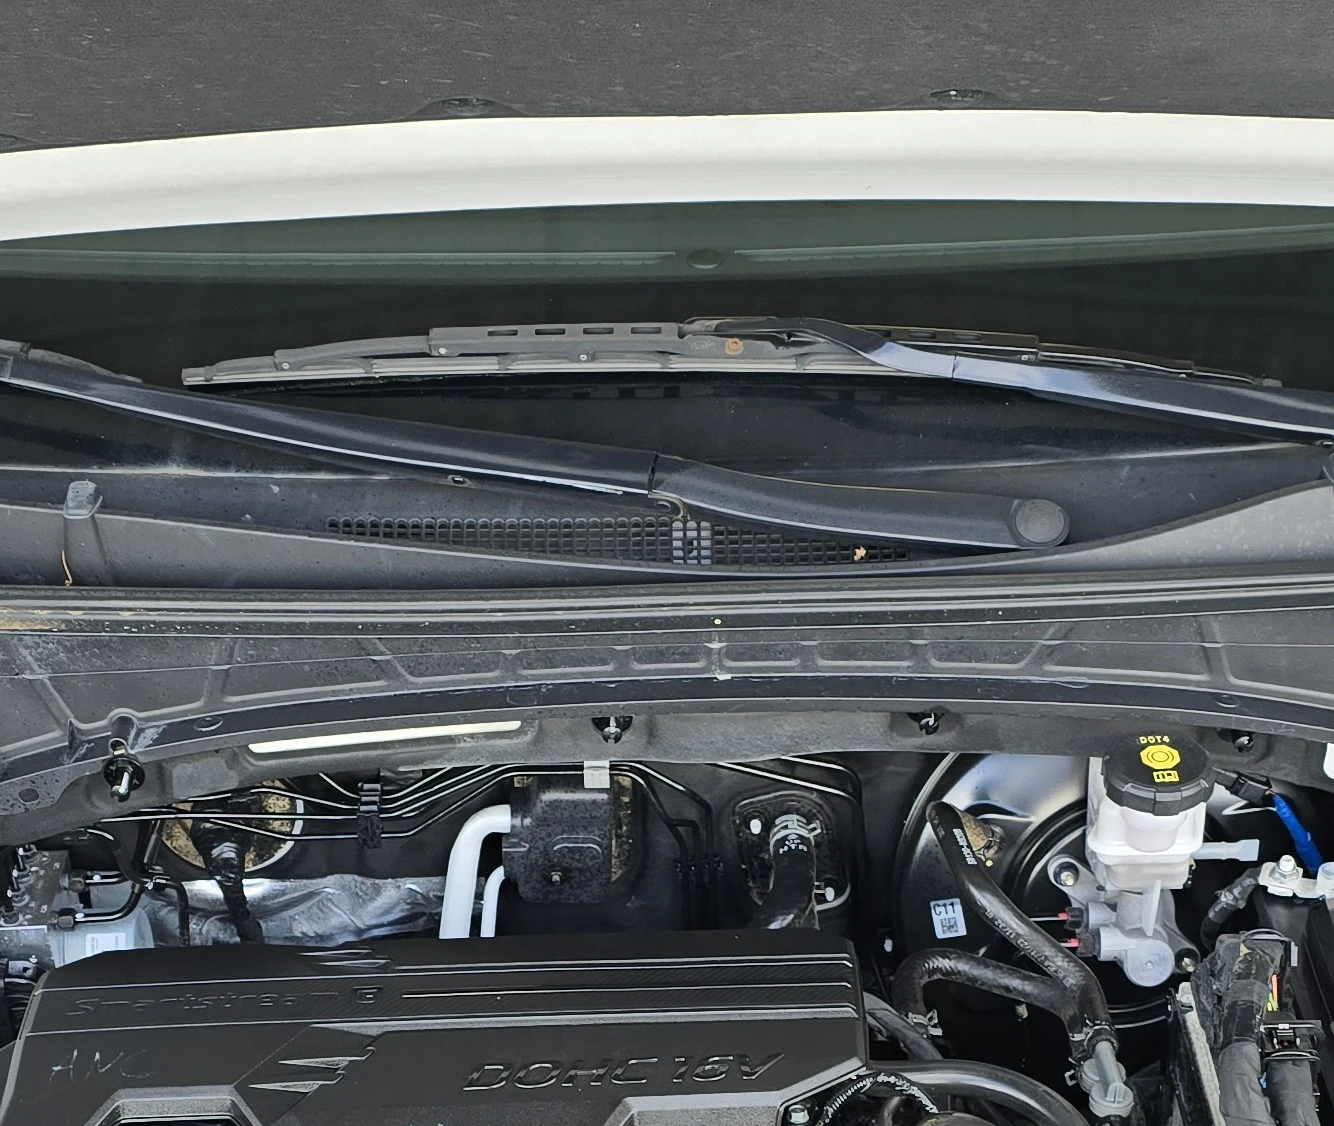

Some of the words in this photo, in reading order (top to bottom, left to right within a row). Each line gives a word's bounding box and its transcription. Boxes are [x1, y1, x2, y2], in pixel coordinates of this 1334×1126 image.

[1139, 735, 1170, 745] DOT4
[932, 903, 957, 916] C11
[465, 1056, 659, 1091] DOHC
[664, 1052, 787, 1086] 16V
